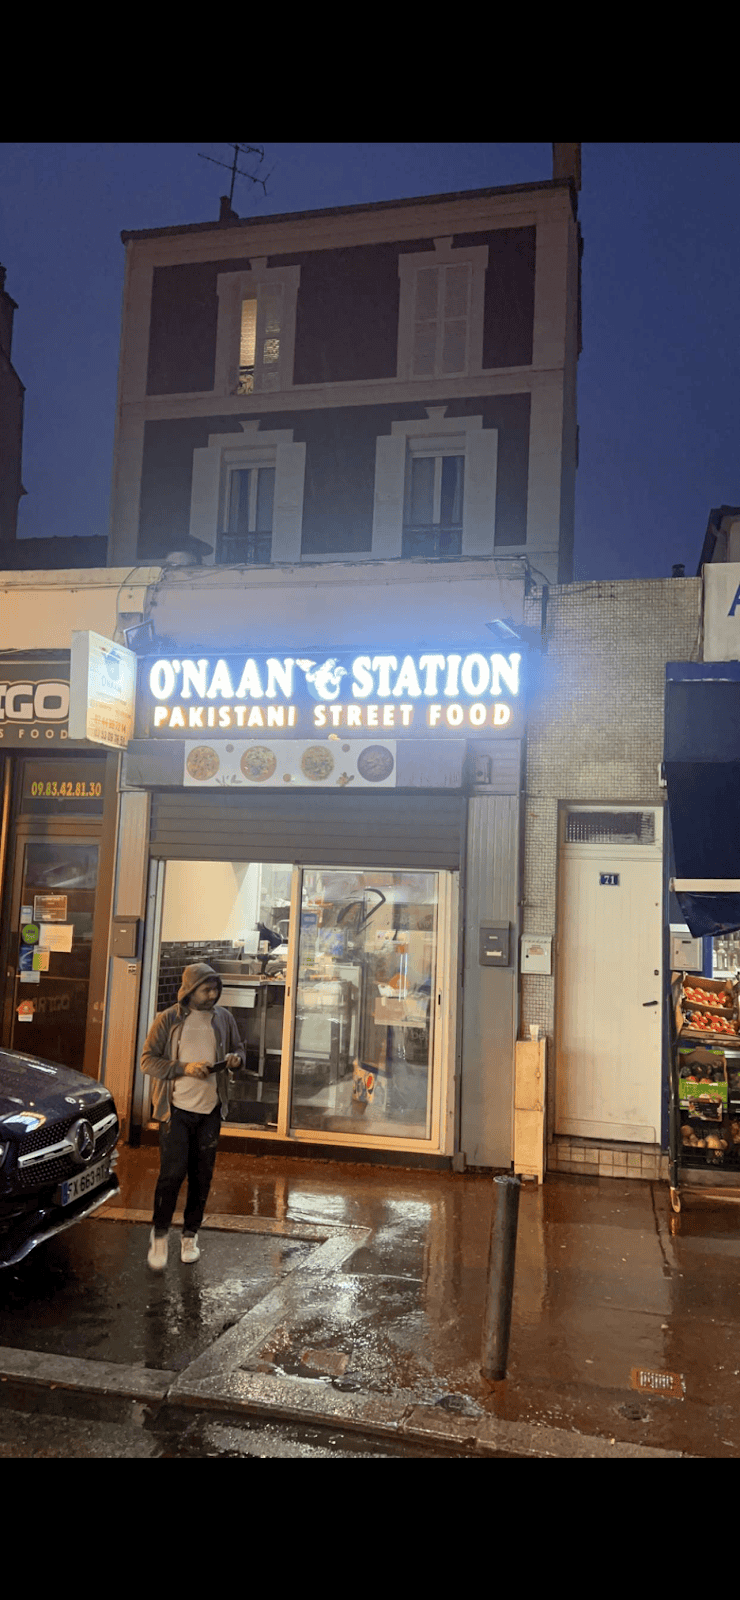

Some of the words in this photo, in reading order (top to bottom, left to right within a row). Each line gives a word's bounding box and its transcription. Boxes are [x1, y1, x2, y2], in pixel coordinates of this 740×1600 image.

[149, 658, 294, 700] O'NAAN
[352, 653, 521, 698] STATION
[153, 705, 297, 727] PAKISTANI
[313, 704, 413, 727] STREET
[429, 703, 511, 726] FOOD
[18, 729, 69, 739] FOOD
[31, 781, 102, 797] 09.83.42.81.30
[603, 875, 615, 885] 71
